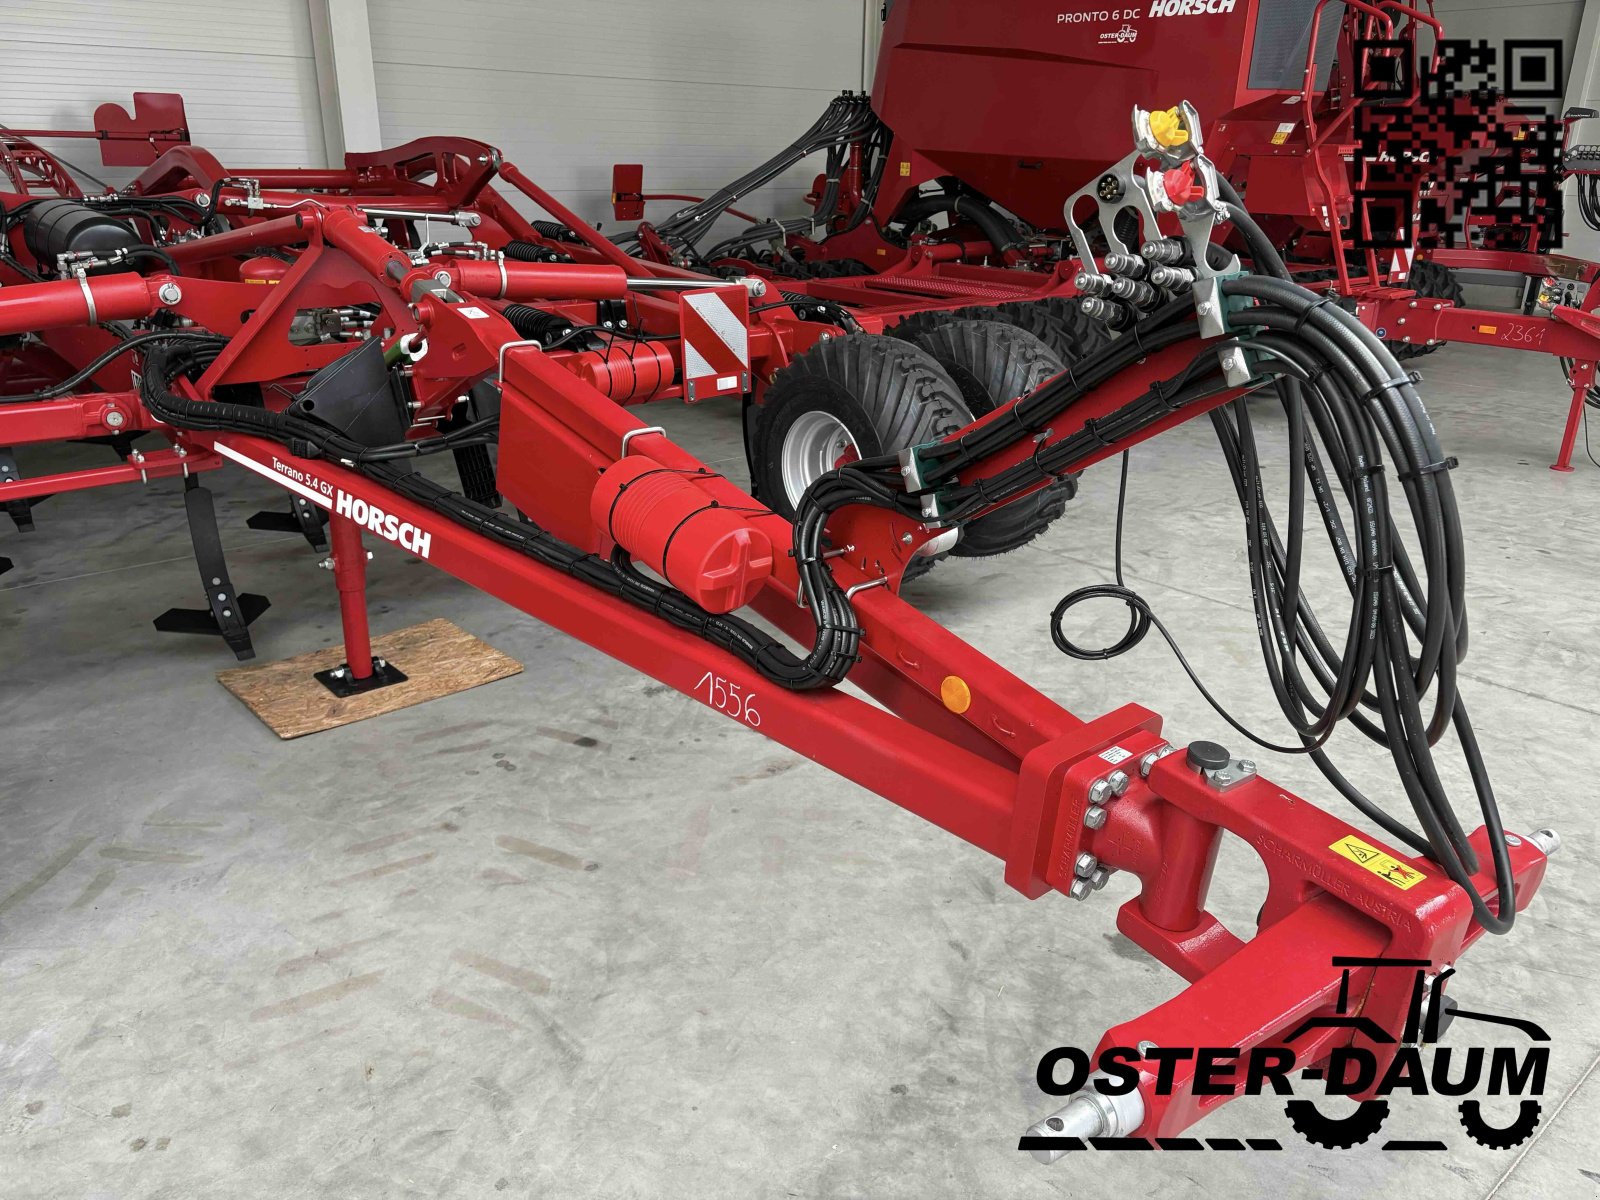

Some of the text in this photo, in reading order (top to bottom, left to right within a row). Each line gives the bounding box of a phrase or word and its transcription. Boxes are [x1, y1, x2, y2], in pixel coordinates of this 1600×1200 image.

[1057, 9, 1140, 23] PRONTO 6 DC
[1148, 0, 1236, 18] HORSCH
[1099, 31, 1137, 40] OSTER-DAUM
[1501, 322, 1546, 346] 2361
[272, 456, 333, 497] Terrano 5.4 GX
[336, 489, 432, 559] HORSCH
[694, 671, 760, 727] 1556
[1353, 891, 1413, 933] AUSTRIA
